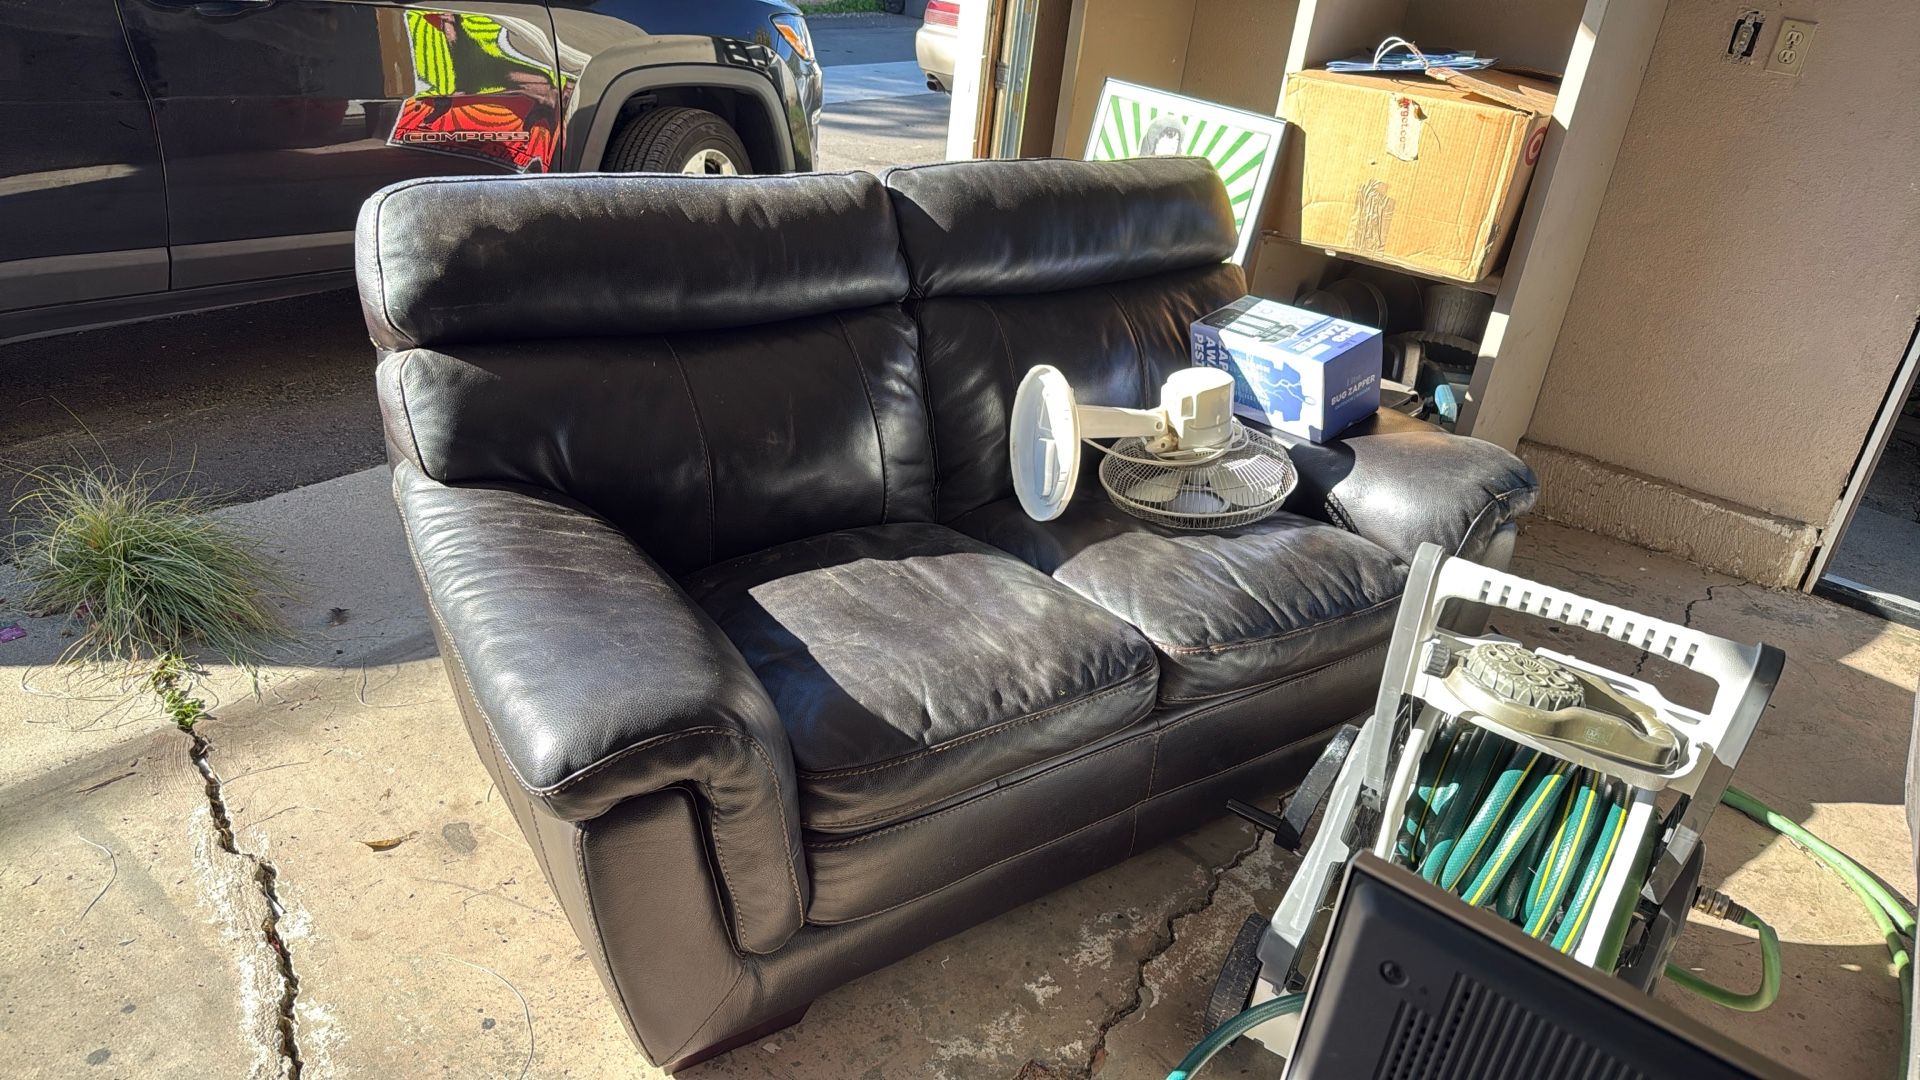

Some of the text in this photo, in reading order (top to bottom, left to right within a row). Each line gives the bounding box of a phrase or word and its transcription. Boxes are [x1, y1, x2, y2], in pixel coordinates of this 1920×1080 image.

[403, 131, 530, 143] COMPASS
[1206, 336, 1217, 367] AW
[1331, 374, 1376, 406] BUG ZAPPER
